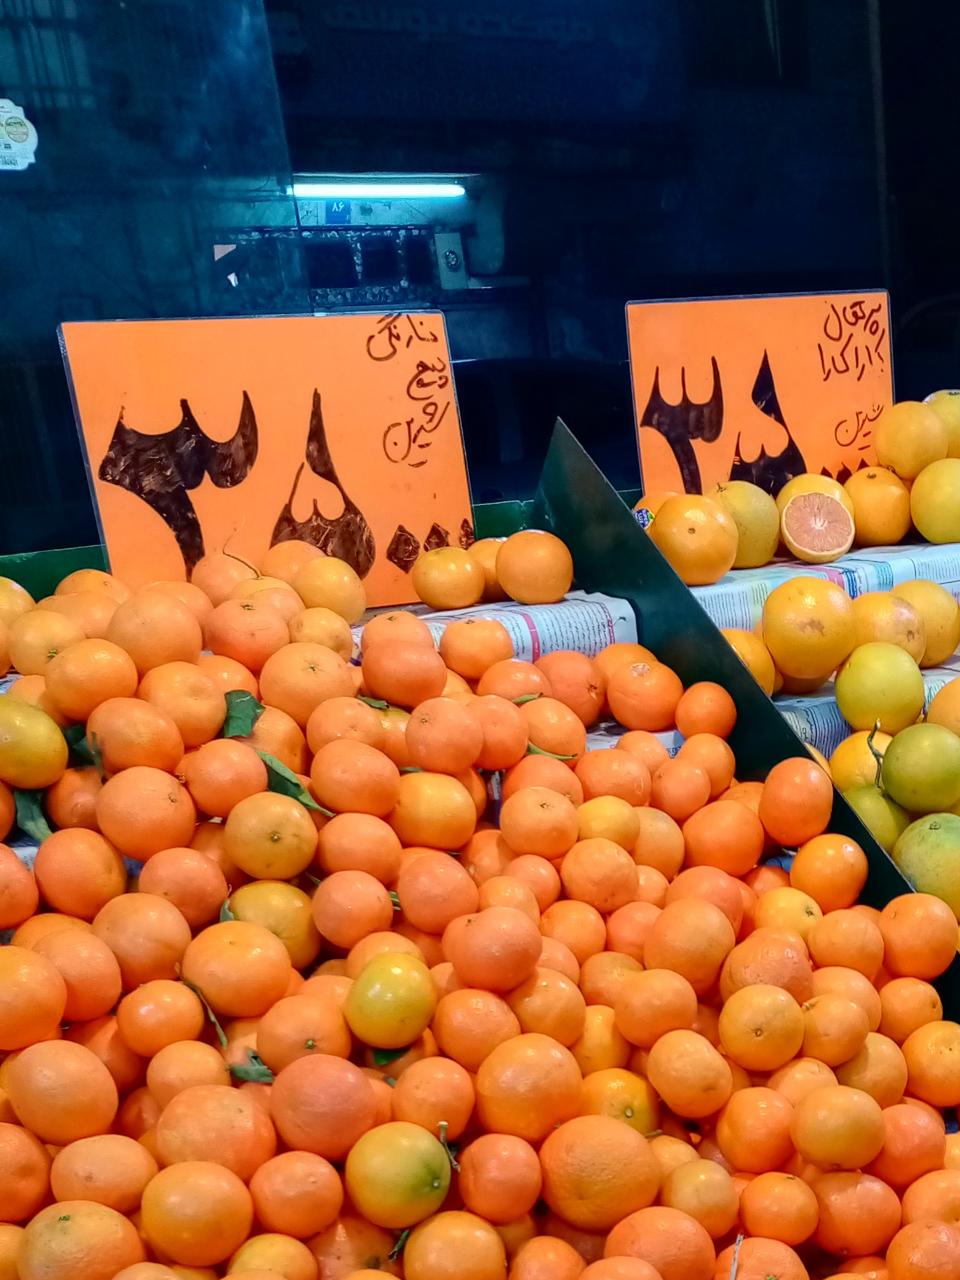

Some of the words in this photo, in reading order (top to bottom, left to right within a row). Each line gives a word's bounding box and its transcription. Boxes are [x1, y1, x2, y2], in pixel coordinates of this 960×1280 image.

[366, 312, 438, 361] نارنگی
[382, 402, 450, 468] شیرین
[834, 404, 885, 450] شیرین
